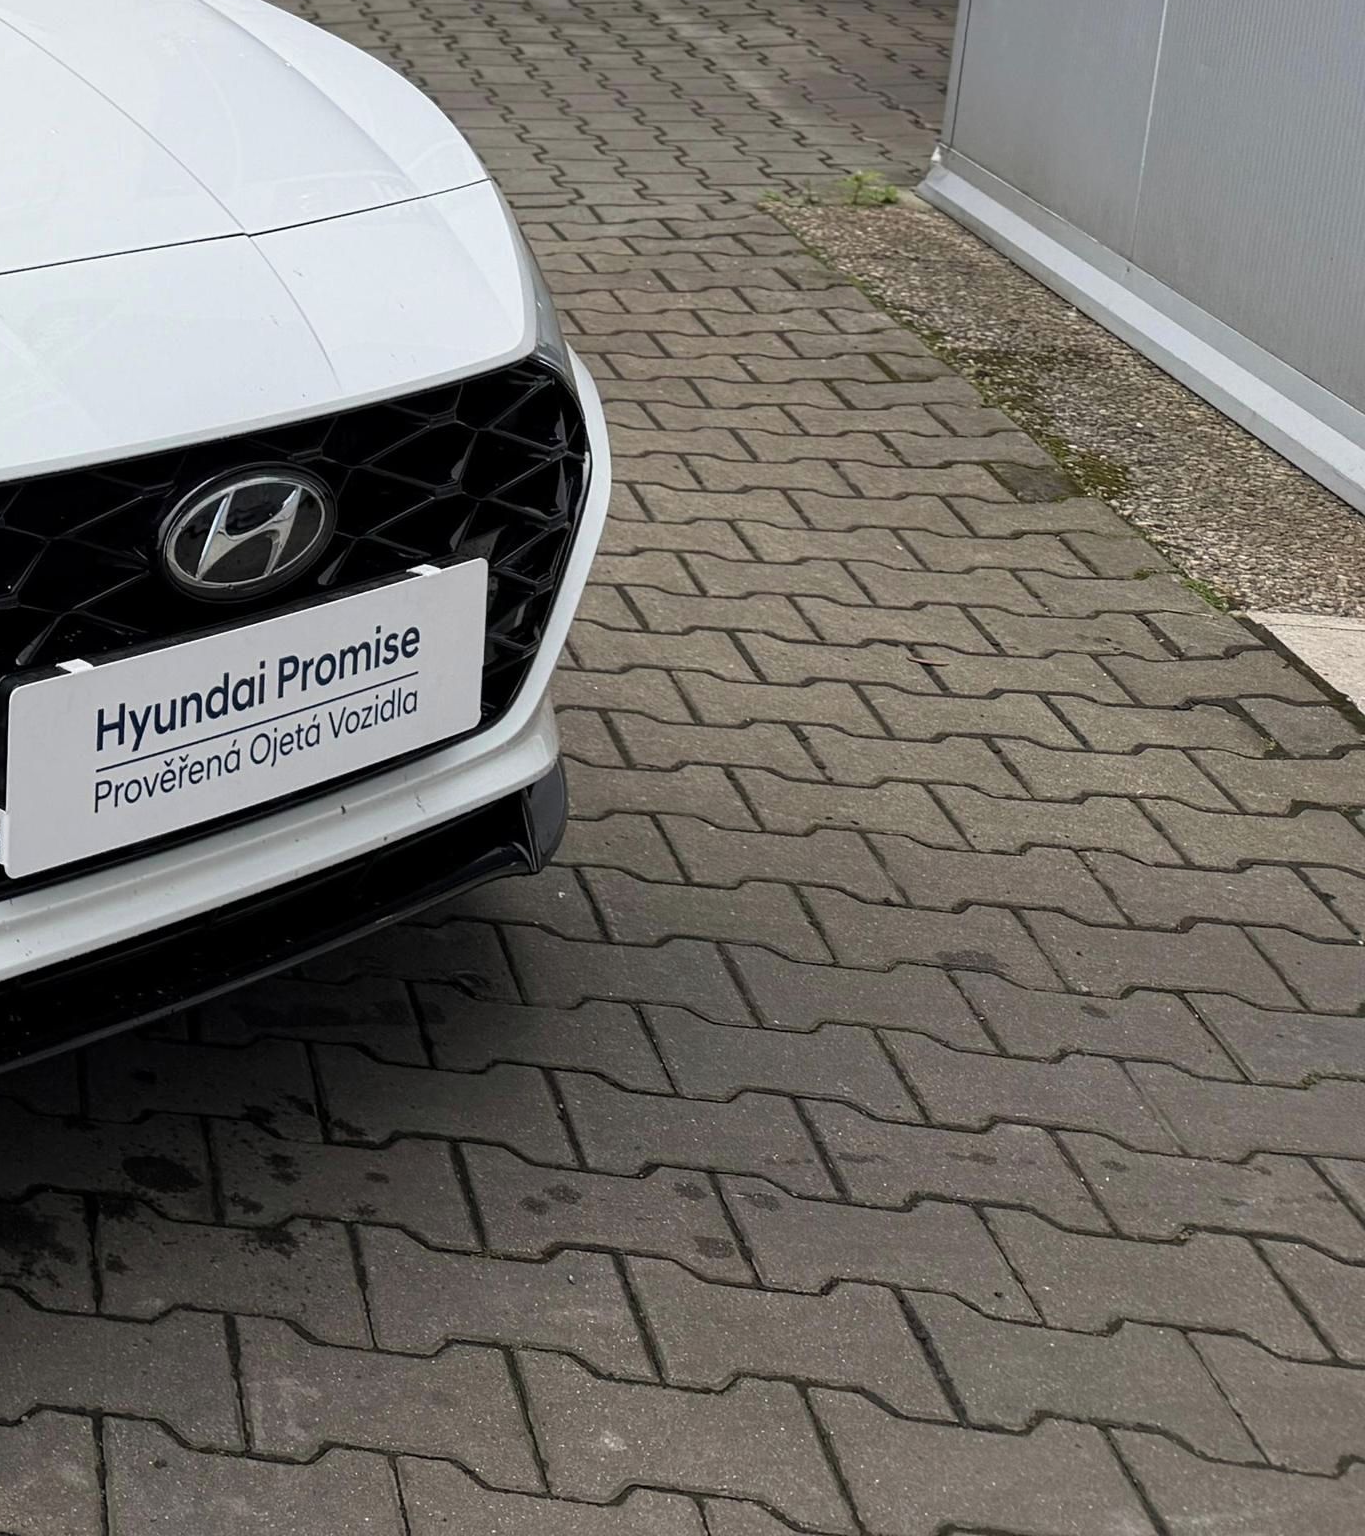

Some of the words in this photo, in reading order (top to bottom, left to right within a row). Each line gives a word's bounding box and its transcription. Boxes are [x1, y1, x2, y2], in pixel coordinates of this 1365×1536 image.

[93, 739, 242, 814] Prověřená
[249, 714, 321, 768] Ojetá
[328, 686, 419, 740] Vozidla
[95, 661, 267, 752] Hyundai
[276, 624, 421, 699] Promise
